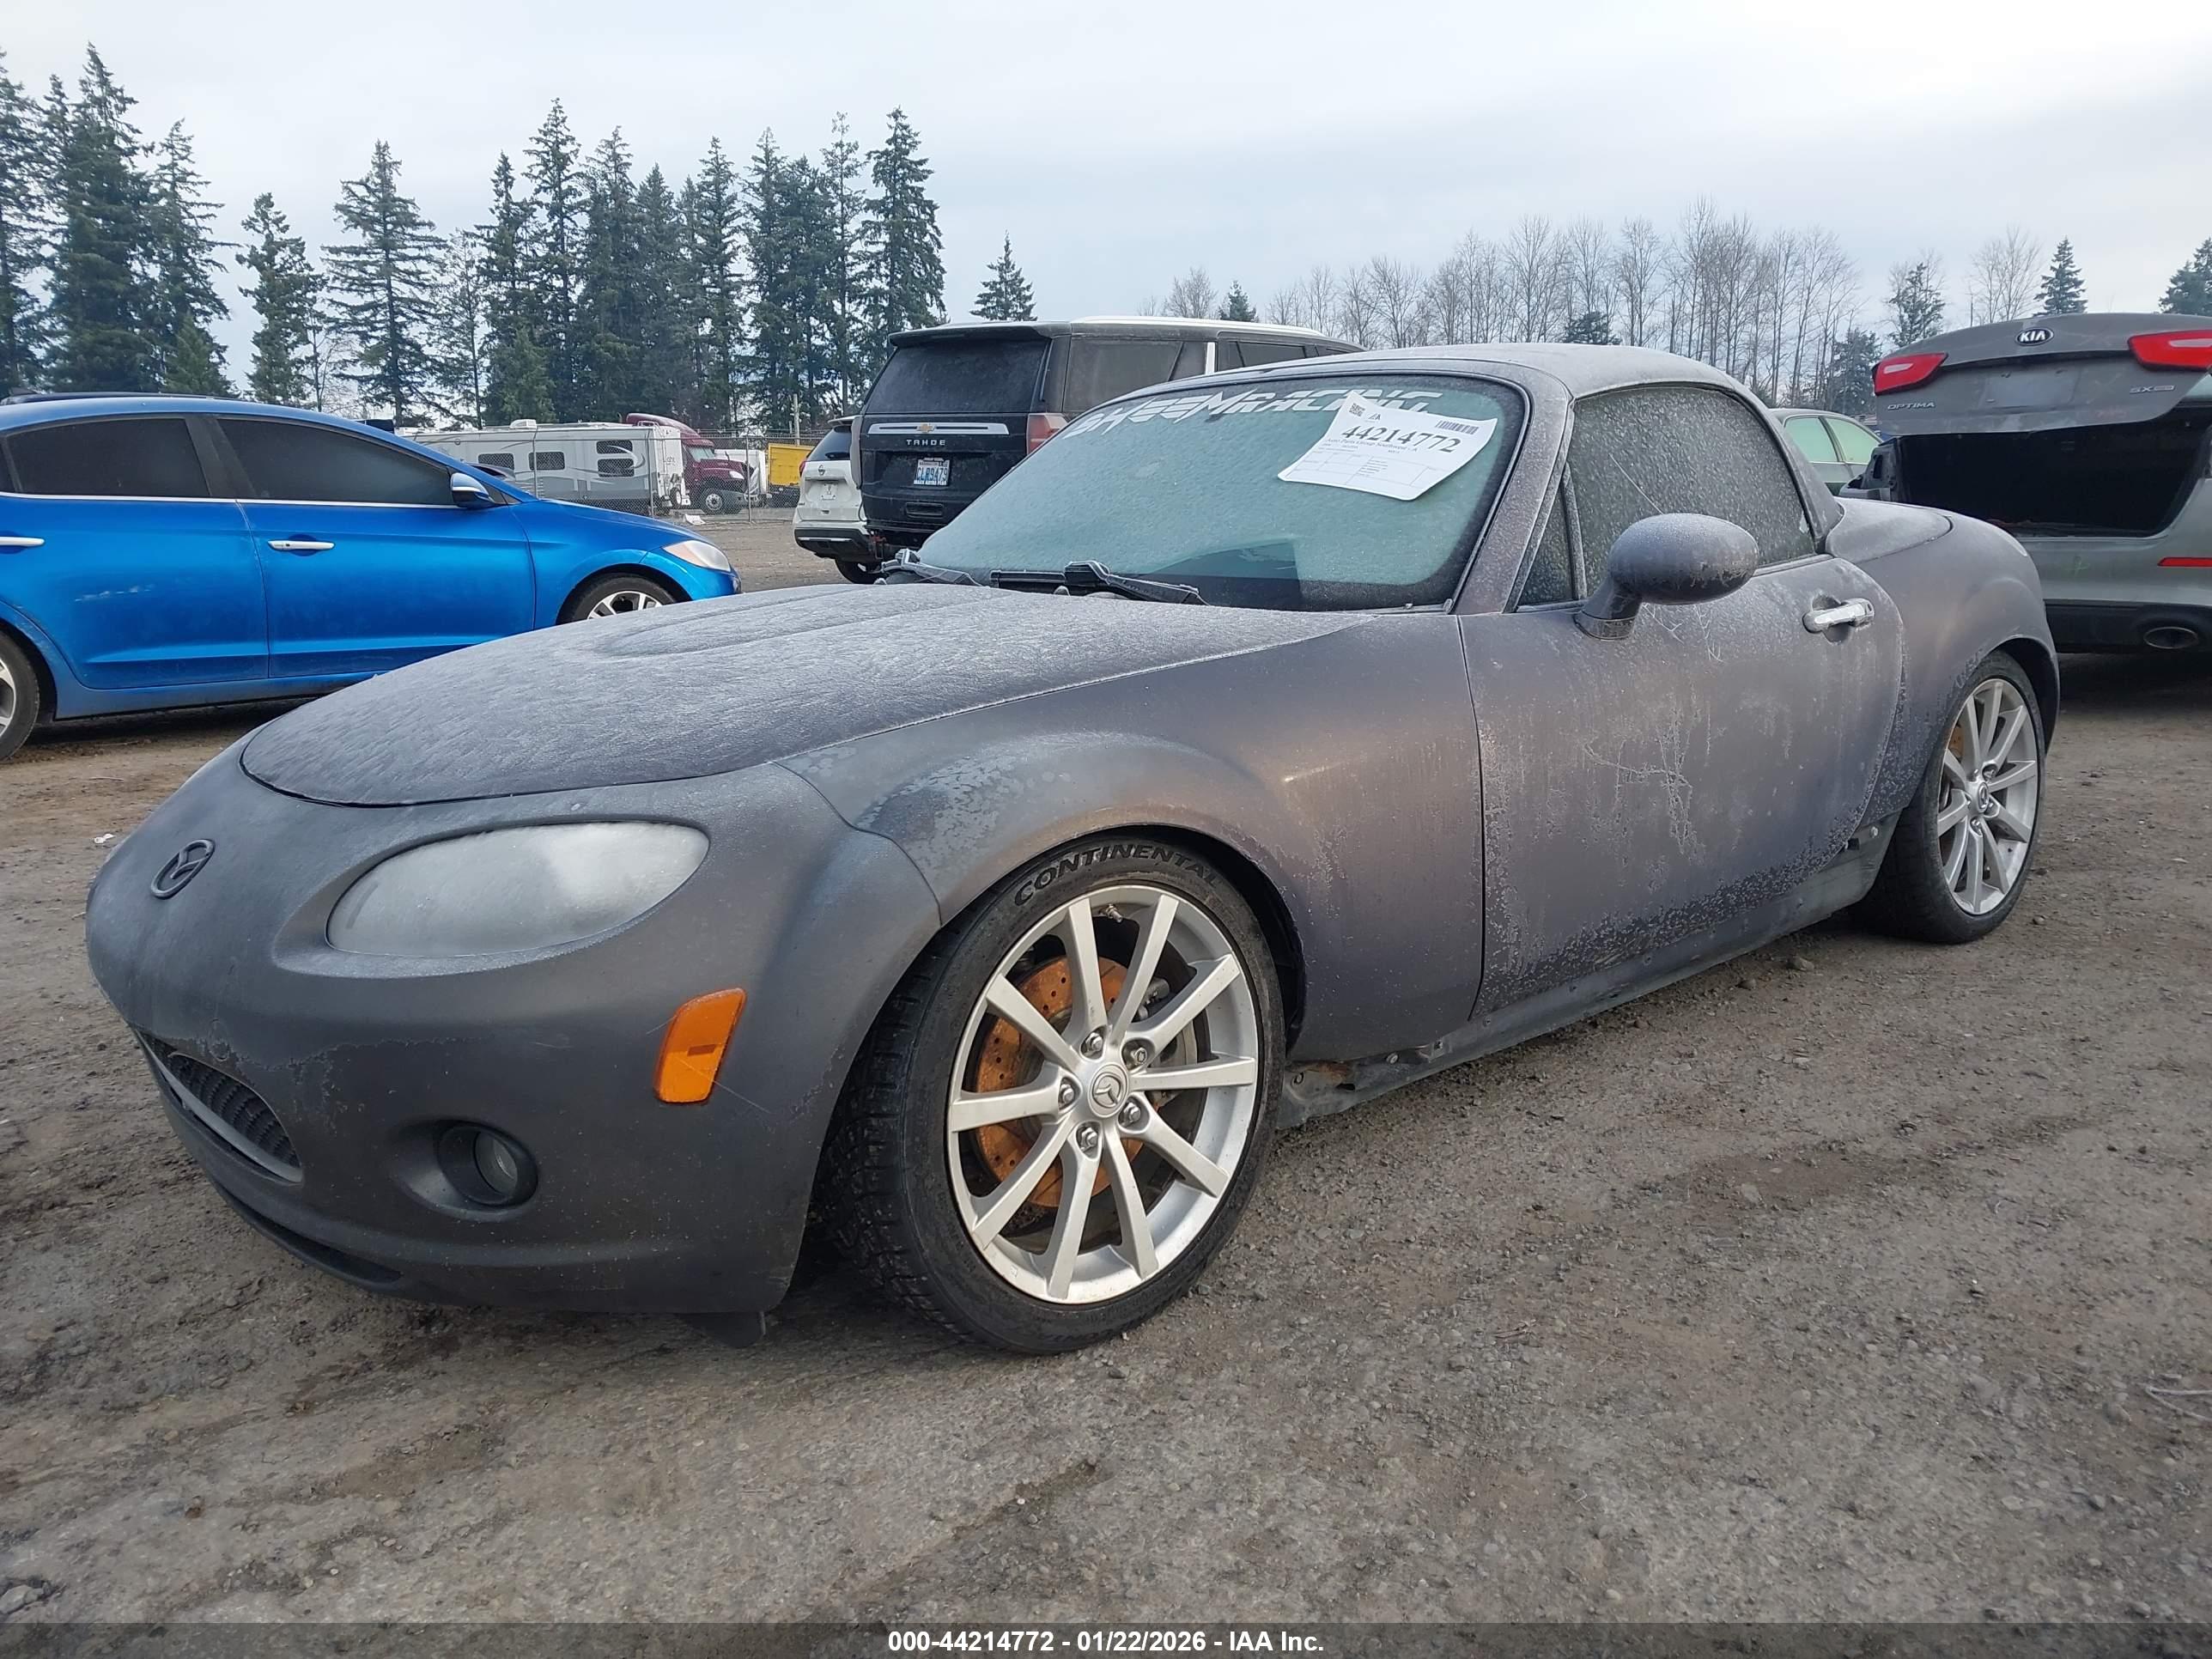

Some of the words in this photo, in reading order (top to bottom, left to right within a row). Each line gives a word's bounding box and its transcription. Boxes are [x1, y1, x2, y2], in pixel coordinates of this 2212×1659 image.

[2020, 330, 2045, 343] KIA
[1342, 425, 1462, 453] 44214772
[1014, 844, 1224, 906] CONTINENTAL
